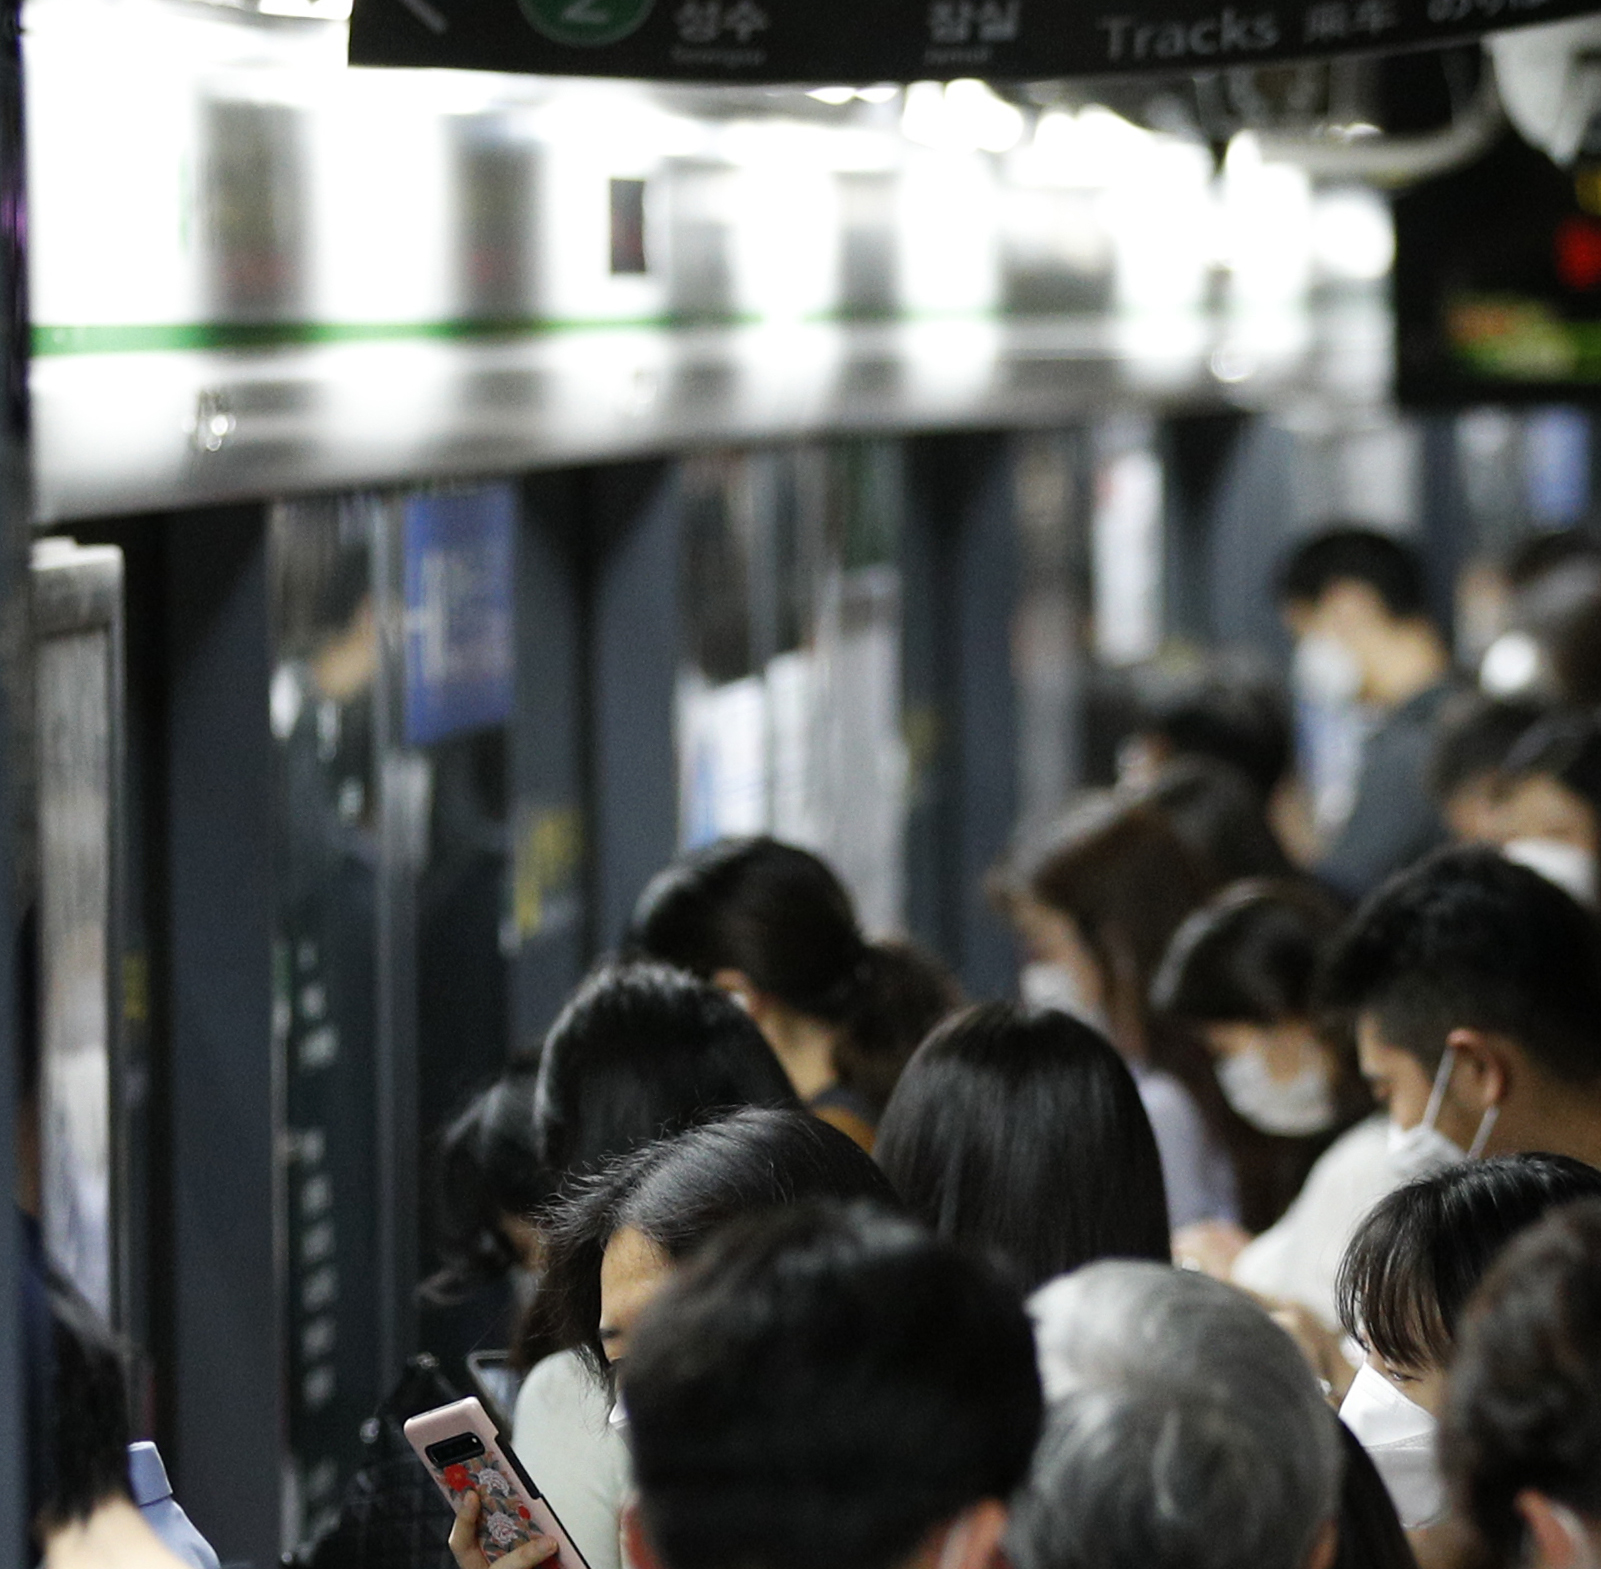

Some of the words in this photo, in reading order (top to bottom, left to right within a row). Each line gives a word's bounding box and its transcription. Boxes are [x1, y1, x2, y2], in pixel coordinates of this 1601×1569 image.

[672, 0, 764, 41] 성수
[927, 0, 1021, 41] 잠실
[1094, 7, 1280, 61] Tracks
